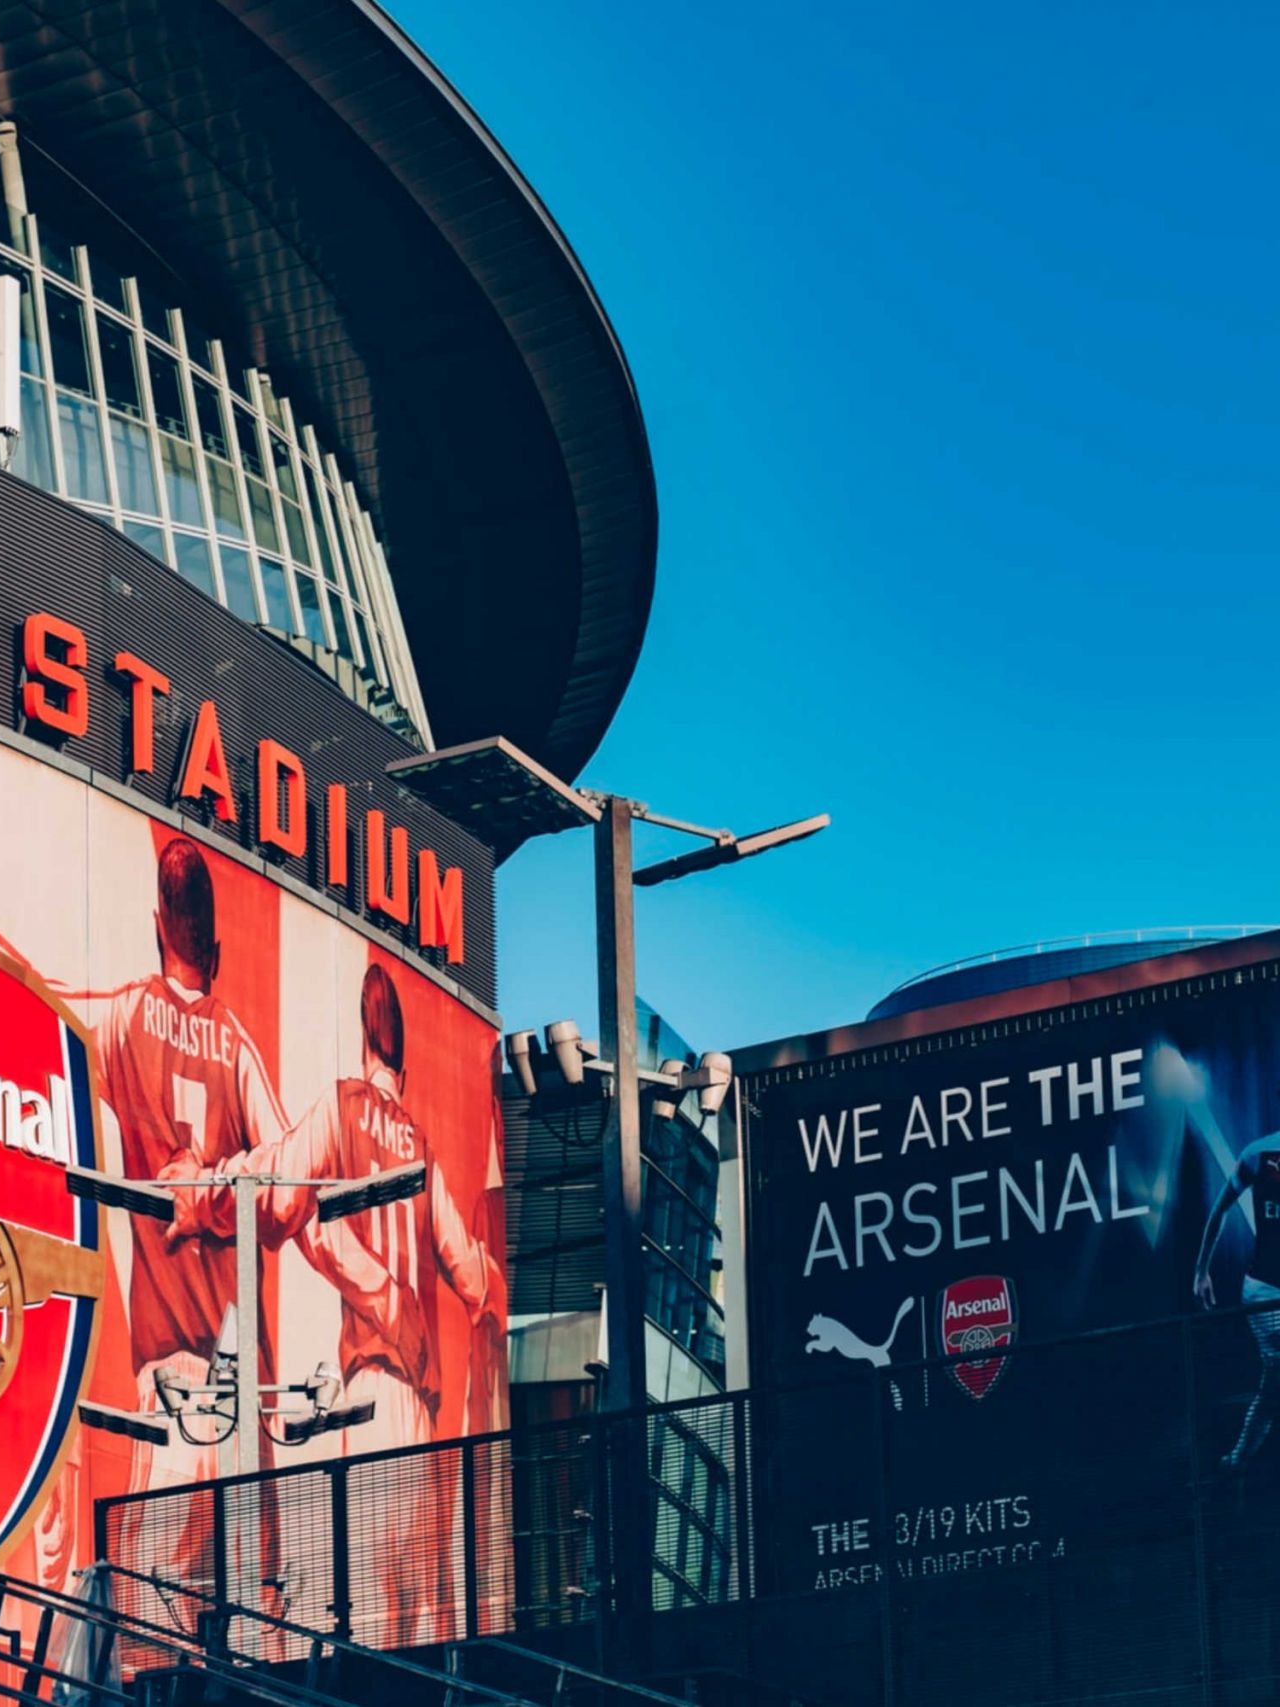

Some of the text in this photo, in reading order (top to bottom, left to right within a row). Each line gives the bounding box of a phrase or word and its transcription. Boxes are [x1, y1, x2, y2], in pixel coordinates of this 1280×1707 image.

[23, 612, 464, 964] STADIUM
[143, 992, 233, 1069] ROCASTLE
[359, 1098, 415, 1161] JAMES
[797, 1048, 1146, 1173] WE ARE THE
[803, 1144, 1151, 1278] ARSENAL
[946, 1291, 1007, 1320] Arsenal
[811, 1518, 870, 1556] THE
[965, 1495, 1031, 1536] KITS
